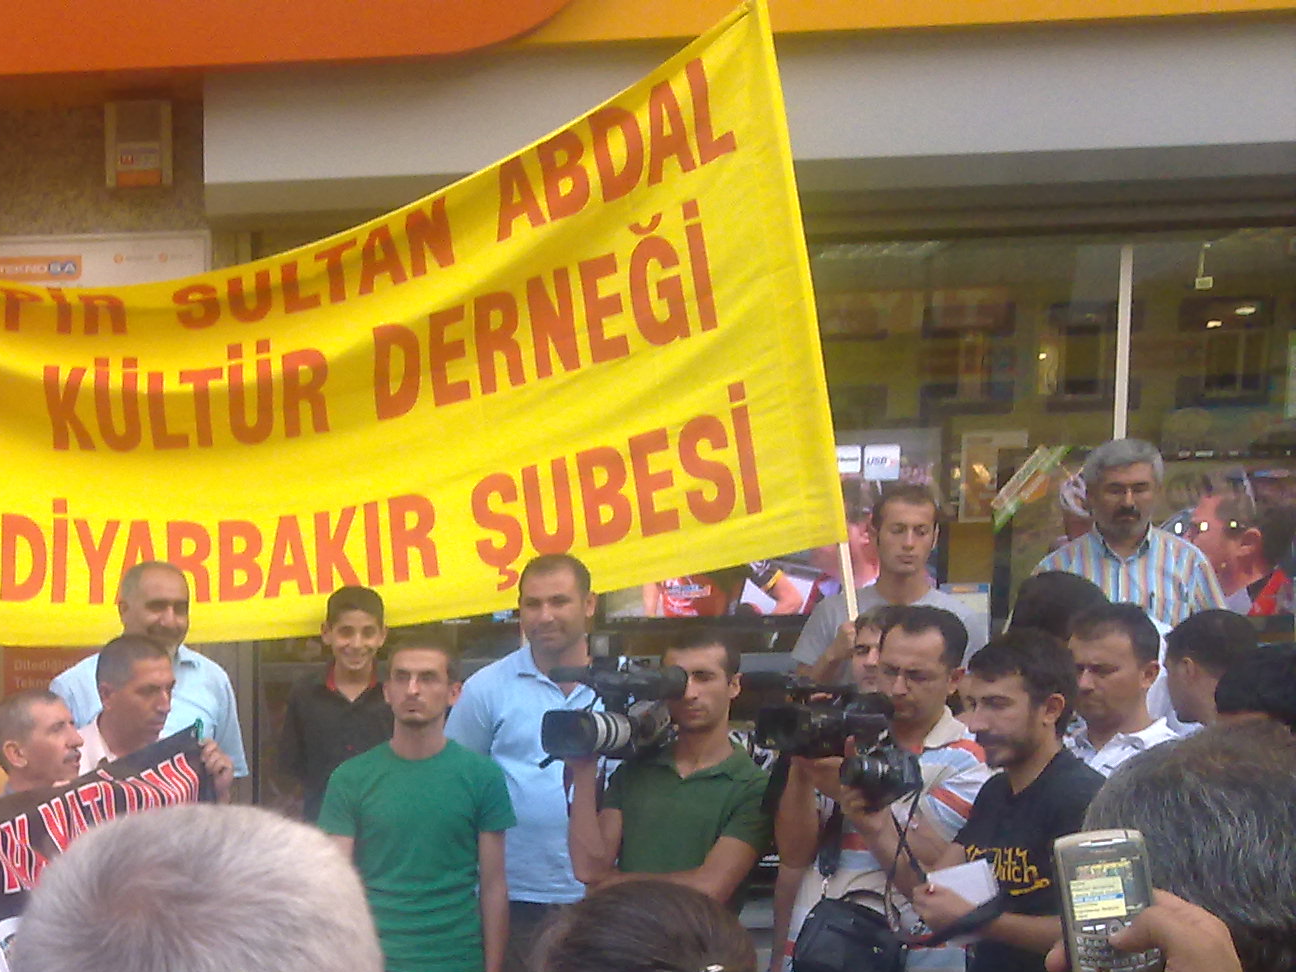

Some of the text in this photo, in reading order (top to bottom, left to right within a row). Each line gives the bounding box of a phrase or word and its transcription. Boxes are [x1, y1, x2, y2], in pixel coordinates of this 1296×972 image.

[172, 196, 456, 329] SULTAN
[496, 57, 737, 243] ABDAL
[43, 199, 718, 452] KÜLTÜR DERNEĞİ
[0, 380, 763, 605] DİYARBAKIR ŞUBESİ
